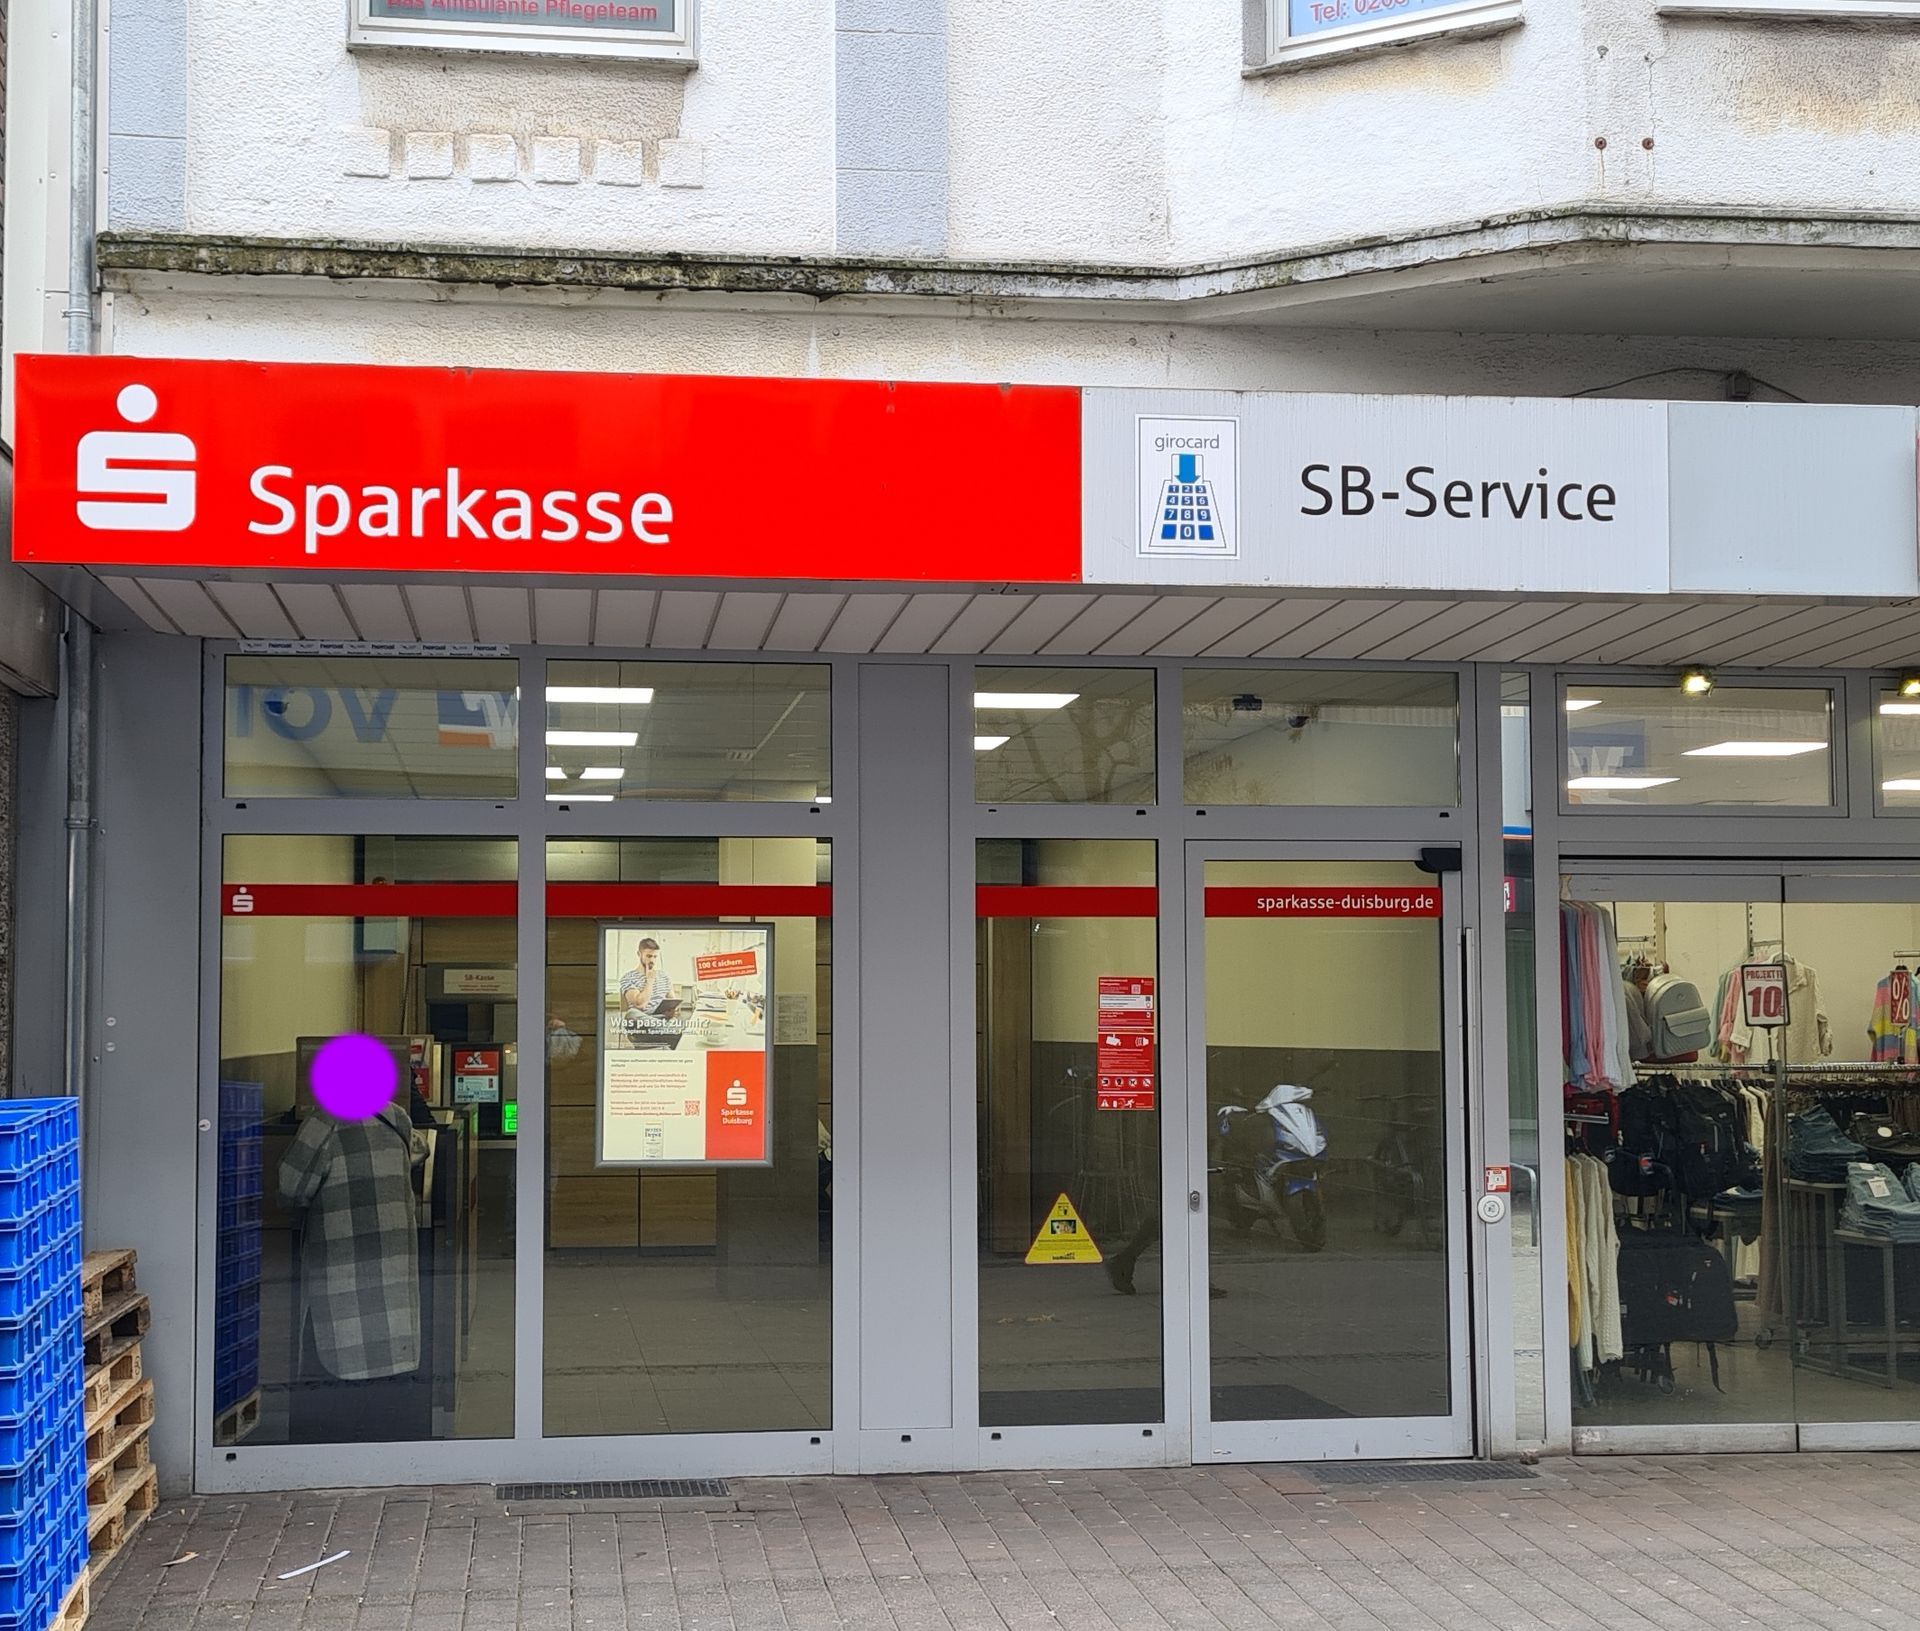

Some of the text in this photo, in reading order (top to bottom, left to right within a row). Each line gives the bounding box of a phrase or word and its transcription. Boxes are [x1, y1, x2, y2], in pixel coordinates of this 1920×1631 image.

[431, 0, 538, 15] Ambulante
[546, 0, 657, 22] Pflegeteam
[1310, 0, 1347, 21] Tel:
[1154, 433, 1220, 452] girocard
[1300, 464, 1617, 521] SB-Service
[248, 464, 674, 555] Sparkasse
[1257, 894, 1434, 912] sparkasse-duisburg.de
[610, 1017, 634, 1027] Was
[637, 1017, 667, 1029] passt
[669, 1018, 683, 1028] zu
[720, 1108, 754, 1117] Sparkasse
[722, 1117, 753, 1125] Duisburg
